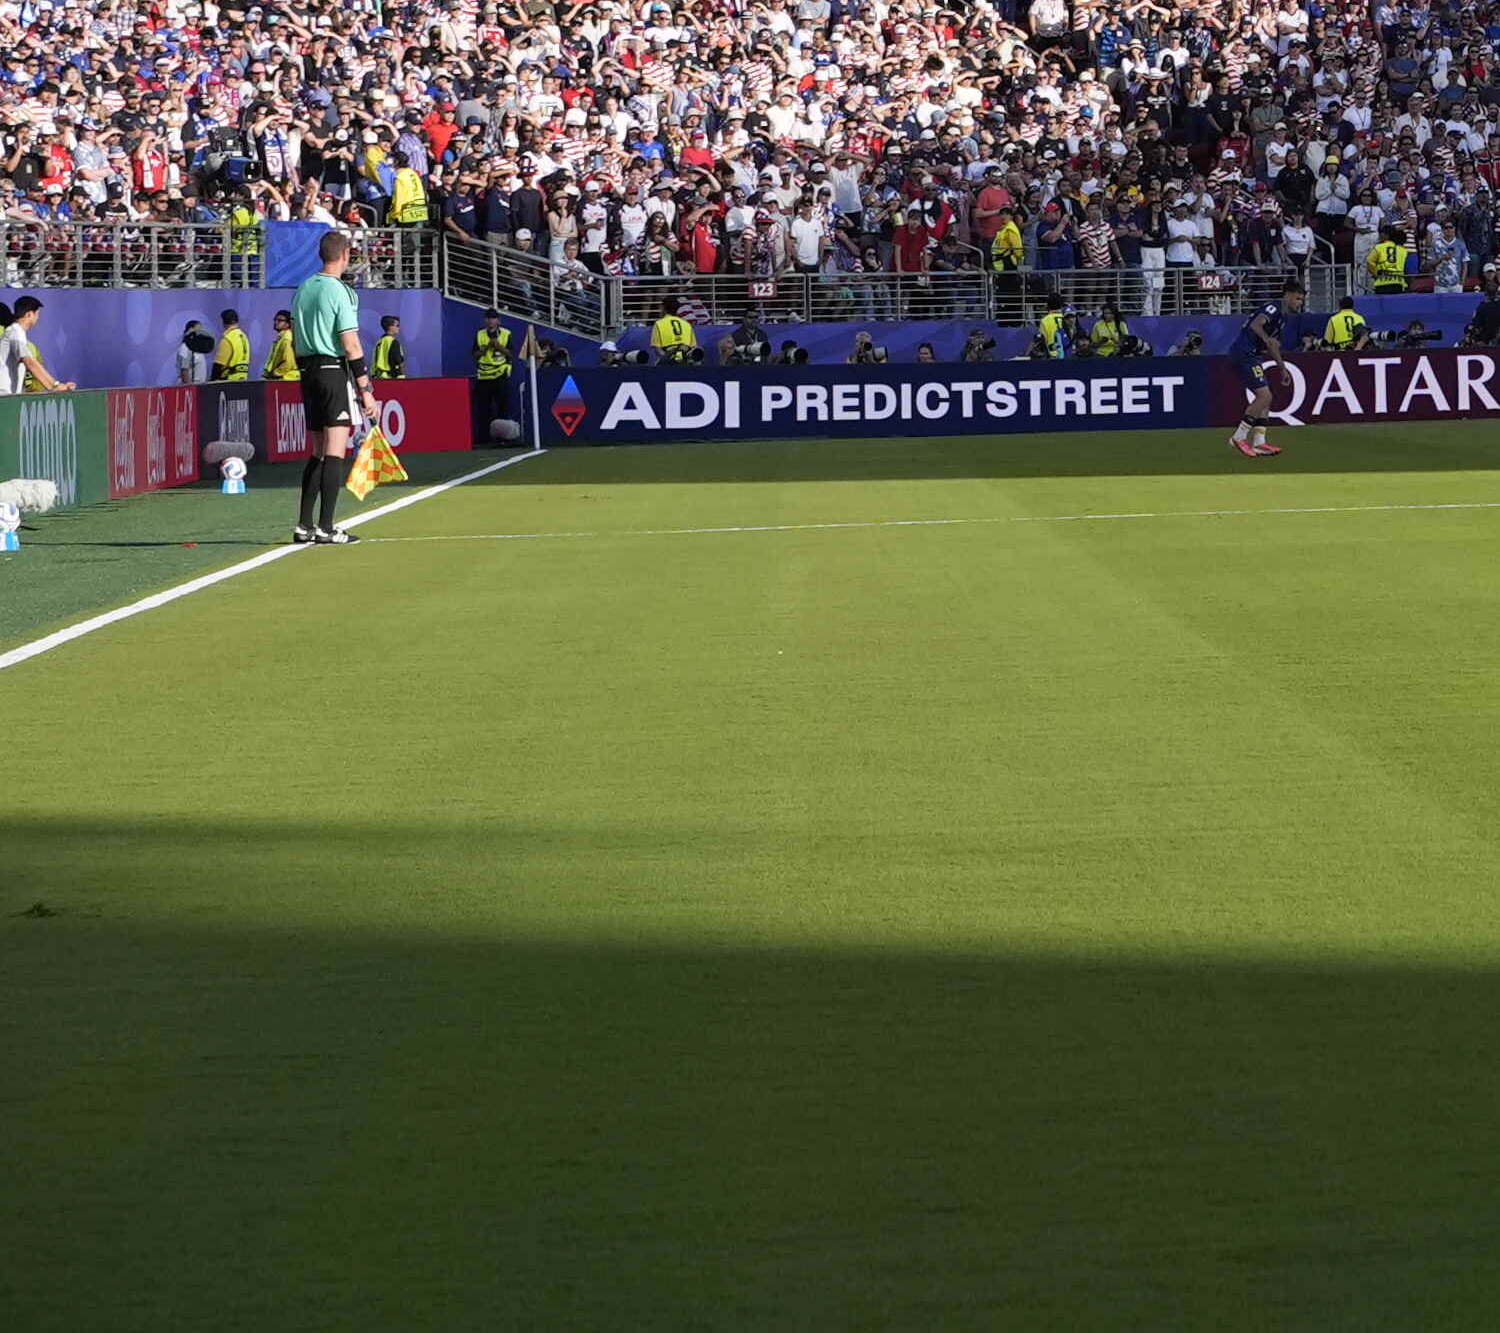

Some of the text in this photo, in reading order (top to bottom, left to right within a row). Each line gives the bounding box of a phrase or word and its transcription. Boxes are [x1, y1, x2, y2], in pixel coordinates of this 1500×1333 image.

[752, 282, 774, 297] 123
[1200, 276, 1221, 289] 124
[601, 376, 1184, 430] ADI PREDICTSTREET
[1246, 353, 1500, 427] QATAR
[275, 388, 307, 454] Lenovo
